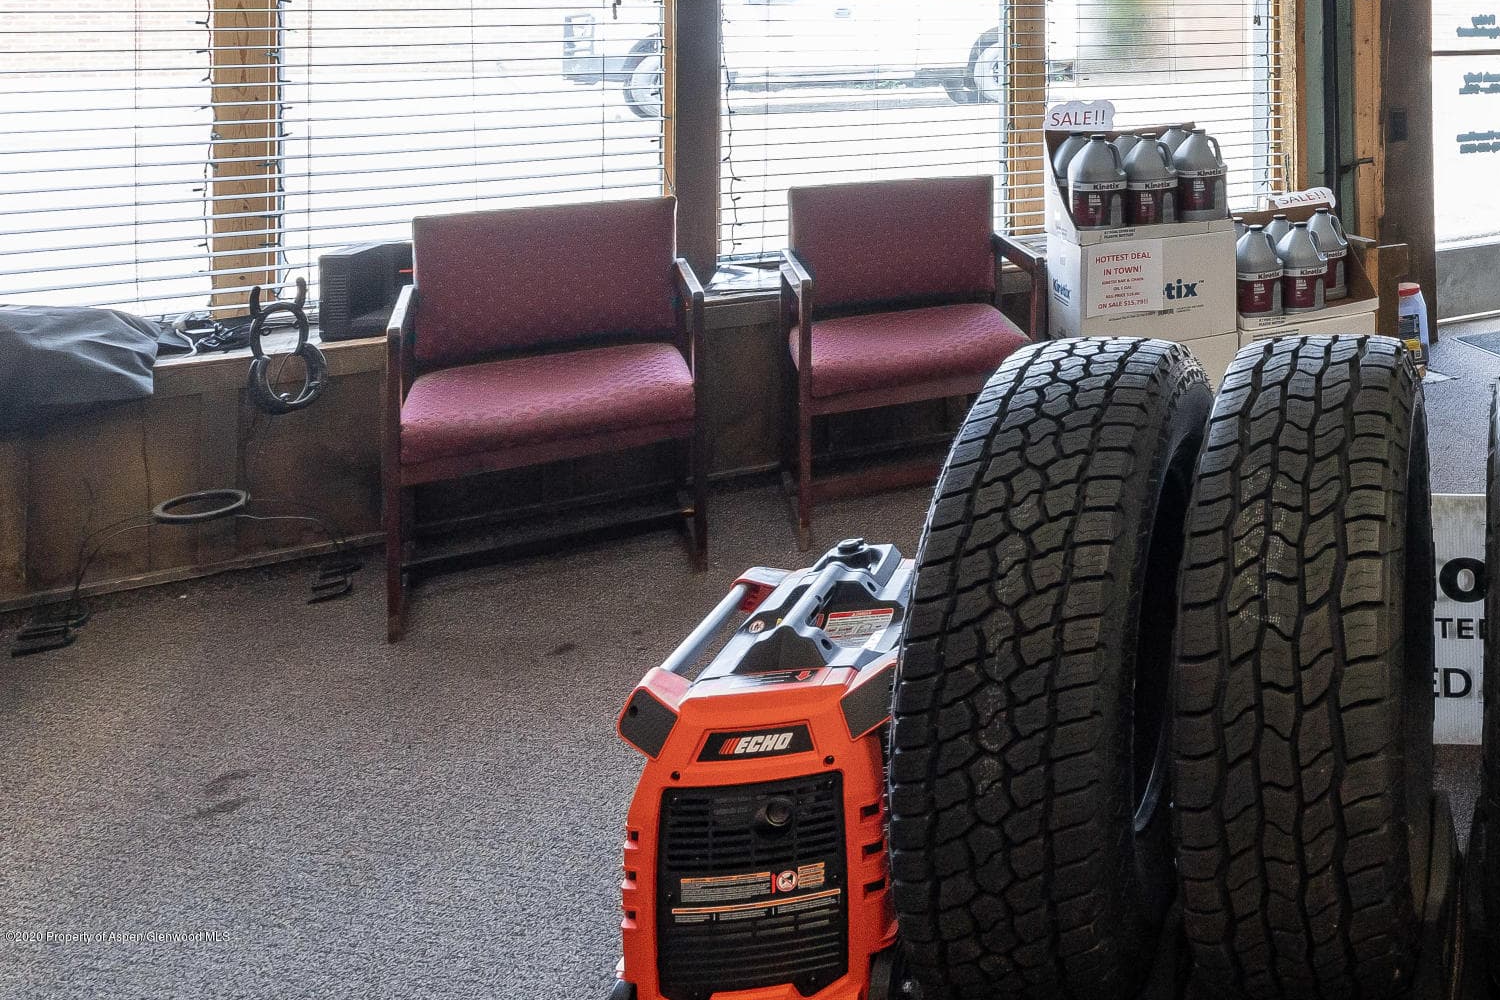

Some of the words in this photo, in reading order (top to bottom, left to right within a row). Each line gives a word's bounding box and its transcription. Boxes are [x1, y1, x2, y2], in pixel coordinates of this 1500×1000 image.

[1050, 109, 1106, 127] SALE!!
[1197, 169, 1223, 177] Kinetix
[1093, 182, 1121, 190] Kinetix
[1144, 181, 1172, 190] Kinetix
[1278, 190, 1329, 206] SALE!!
[1095, 253, 1130, 265] HOTTEST
[1131, 251, 1151, 260] DEAL
[1114, 266, 1142, 275] TOWN!
[1301, 266, 1322, 275] Kinetix
[1257, 271, 1280, 280] Kinetix
[1163, 278, 1198, 300] tix
[734, 732, 794, 755] ECHO
